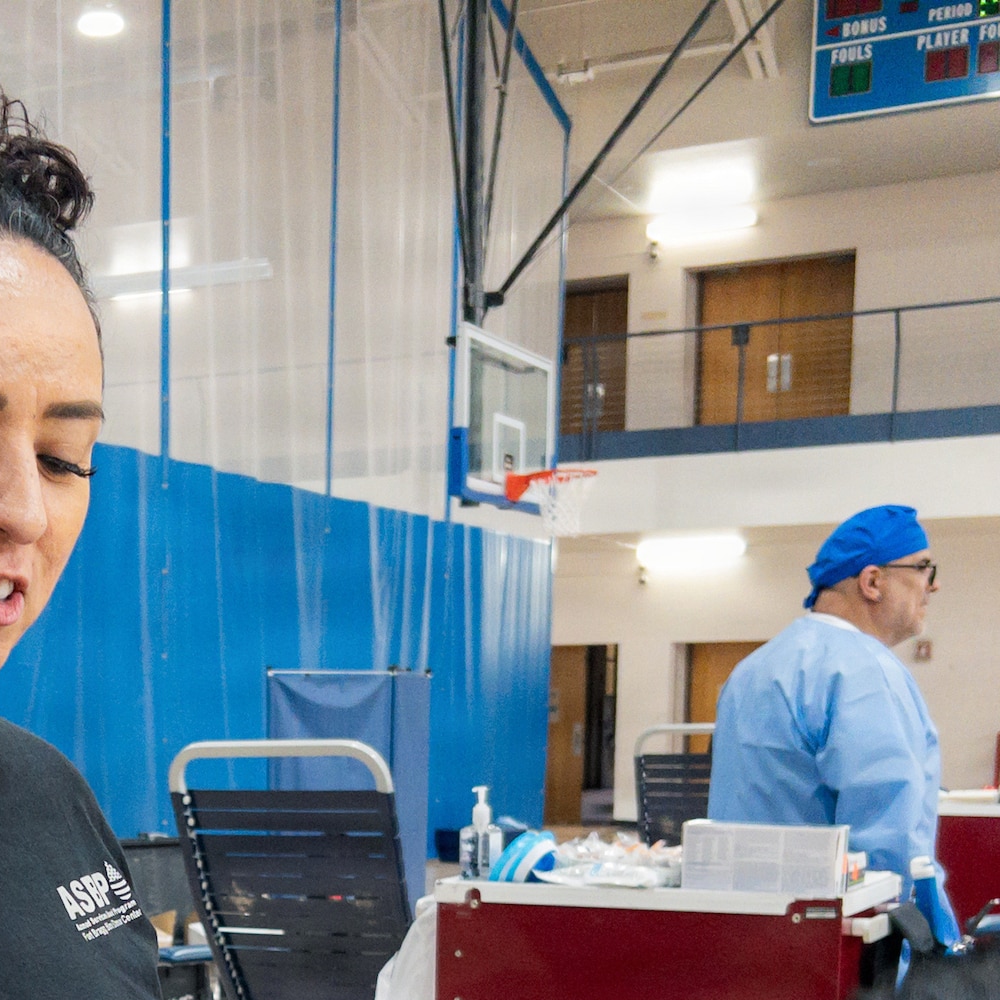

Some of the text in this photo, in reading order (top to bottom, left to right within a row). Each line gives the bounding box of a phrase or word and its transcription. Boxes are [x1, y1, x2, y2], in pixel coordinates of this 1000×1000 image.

[928, 3, 972, 22] PERIOD
[842, 17, 887, 38] BONUS
[917, 28, 969, 50] PLAYER
[831, 44, 873, 64] FOULS
[120, 908, 143, 924] Center
